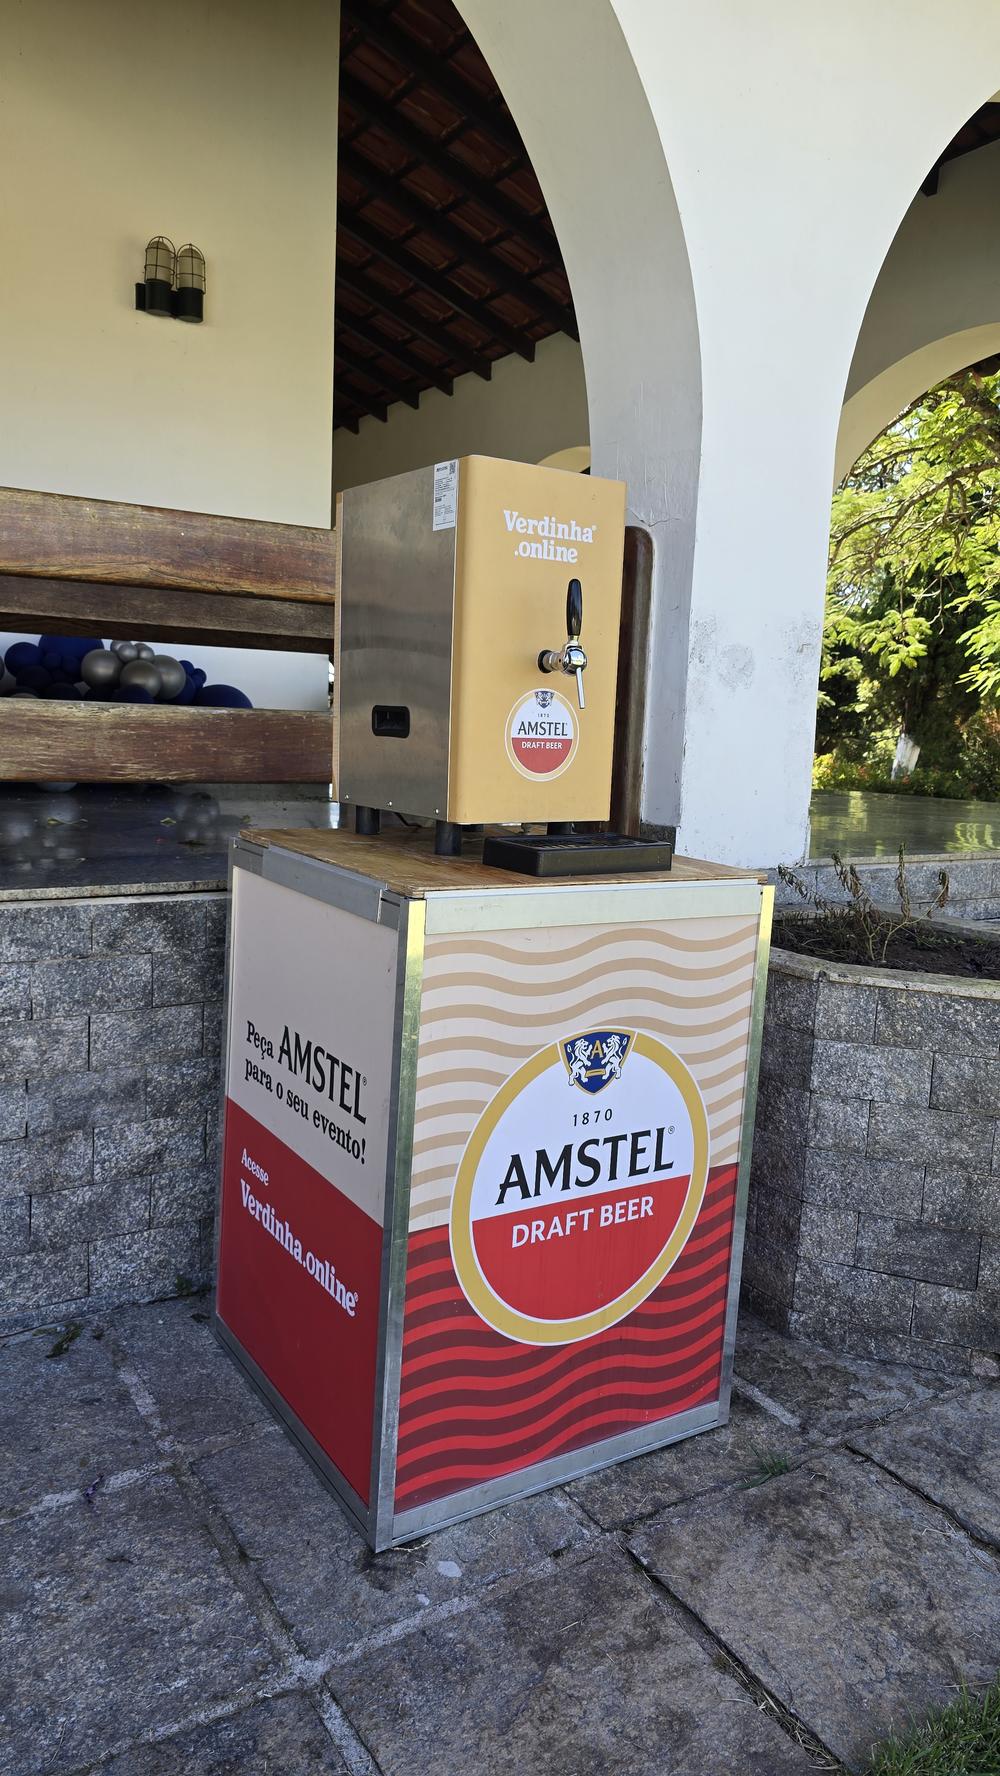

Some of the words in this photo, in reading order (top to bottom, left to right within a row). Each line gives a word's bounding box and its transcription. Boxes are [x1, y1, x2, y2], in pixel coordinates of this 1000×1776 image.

[514, 540, 578, 563] .online
[521, 741, 545, 749] DRAFT
[246, 1020, 274, 1060] Peça
[244, 1058, 273, 1093] para
[276, 1082, 283, 1099] o
[286, 1089, 309, 1120] seu
[312, 1109, 366, 1165] evento!
[572, 1108, 613, 1127] 1870
[240, 1148, 269, 1186] Acesse
[511, 1208, 594, 1249] DRAFT
[599, 1196, 654, 1228] BEER
